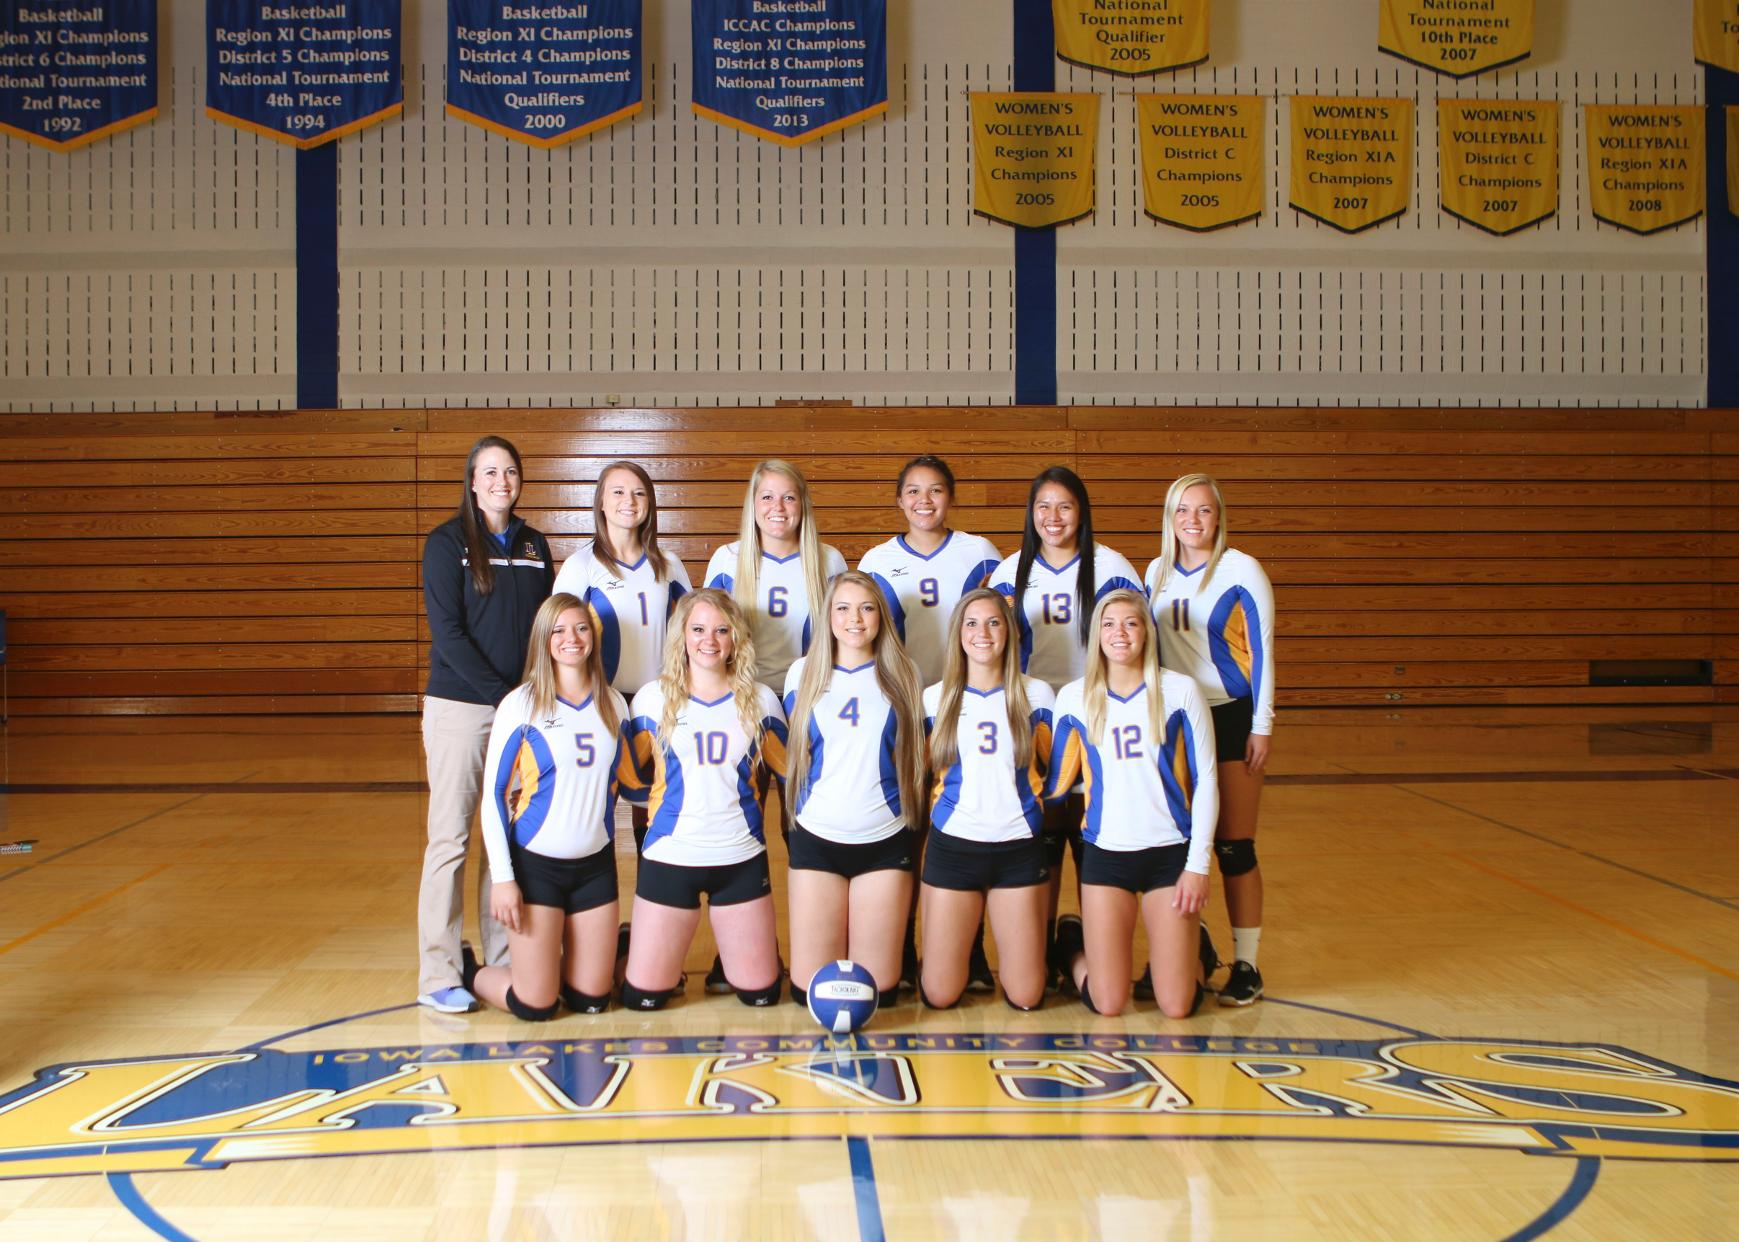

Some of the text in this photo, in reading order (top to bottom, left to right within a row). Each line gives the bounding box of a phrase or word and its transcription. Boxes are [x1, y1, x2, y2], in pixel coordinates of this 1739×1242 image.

[261, 5, 346, 20] Basketball
[502, 5, 587, 20] Basketball
[753, 0, 826, 14] Basketball
[1095, 0, 1168, 10] National
[1423, 0, 1494, 10] National
[18, 8, 103, 22] Basketball
[1079, 12, 1184, 25] Tournament
[1408, 13, 1510, 29] Tournament
[724, 17, 855, 34] ICCAC Champions
[35, 31, 52, 44] XI
[57, 29, 149, 46] Champions
[216, 26, 392, 45] Region XI Champions
[457, 26, 633, 43] Region XI Champions
[1096, 29, 1165, 45] Qualifier
[1421, 31, 1498, 45] 10th Place
[713, 37, 866, 53] Region XI Champions
[39, 53, 49, 66] 6
[54, 51, 147, 68] Champions
[219, 48, 389, 65] District 5 Champions
[459, 48, 631, 65] District 4 Champions
[1110, 48, 1151, 61] 2005
[1440, 48, 1477, 60] 2007
[715, 56, 864, 72] District 8 Champions
[50, 74, 147, 87] Tournament
[219, 70, 390, 86] National Tournament
[459, 69, 631, 86] National Tournament
[715, 76, 865, 89] National Tournament
[22, 96, 102, 110] 2nd Place
[266, 93, 342, 107] 4th Place
[504, 93, 585, 109] Qualifiers
[756, 95, 825, 110] Qualifiers
[995, 102, 1073, 115] WOMEN'S
[1161, 104, 1238, 117] WOMEN'S
[1313, 106, 1389, 119] WOMEN'S
[1461, 109, 1536, 122] WOMEN'S
[43, 117, 82, 132] 1992
[285, 115, 325, 130] 1994
[524, 115, 566, 130] 2000
[774, 115, 809, 128] 2013
[1608, 115, 1682, 128] WOMEN'S
[985, 124, 1083, 136] VOLLEYBALL
[1152, 125, 1248, 139] VOLLEYBALL
[1304, 127, 1398, 142] VOLLEYBALL
[1452, 131, 1547, 145] VOLLEYBALL
[1599, 137, 1690, 150] VOLLEYBALL
[995, 146, 1073, 161] Region XI
[1164, 147, 1236, 160] District C
[1306, 149, 1358, 165] Region
[1465, 152, 1534, 165] District C
[1601, 158, 1651, 172] Region
[991, 168, 1078, 183] Champions
[1157, 169, 1243, 184] Champions
[1309, 171, 1393, 186] Champions
[1458, 175, 1542, 189] Champions
[1603, 178, 1685, 193] Champions
[1015, 193, 1055, 206] 2005
[1180, 194, 1220, 207] 2005
[1334, 197, 1368, 210] 2007
[1482, 200, 1518, 213] 2007
[1628, 200, 1662, 212] 2008
[919, 578, 940, 608] 9
[637, 591, 649, 626] 1
[768, 586, 788, 618] 6
[1041, 593, 1072, 625] 13
[1171, 598, 1191, 631] 11
[838, 696, 859, 727] 4
[977, 721, 998, 755] 3
[1112, 724, 1143, 760] 12
[575, 733, 596, 768] 5
[694, 731, 729, 766] 10
[314, 1037, 1319, 1065] IOWA LAKES COMMUNITY COLLEGE
